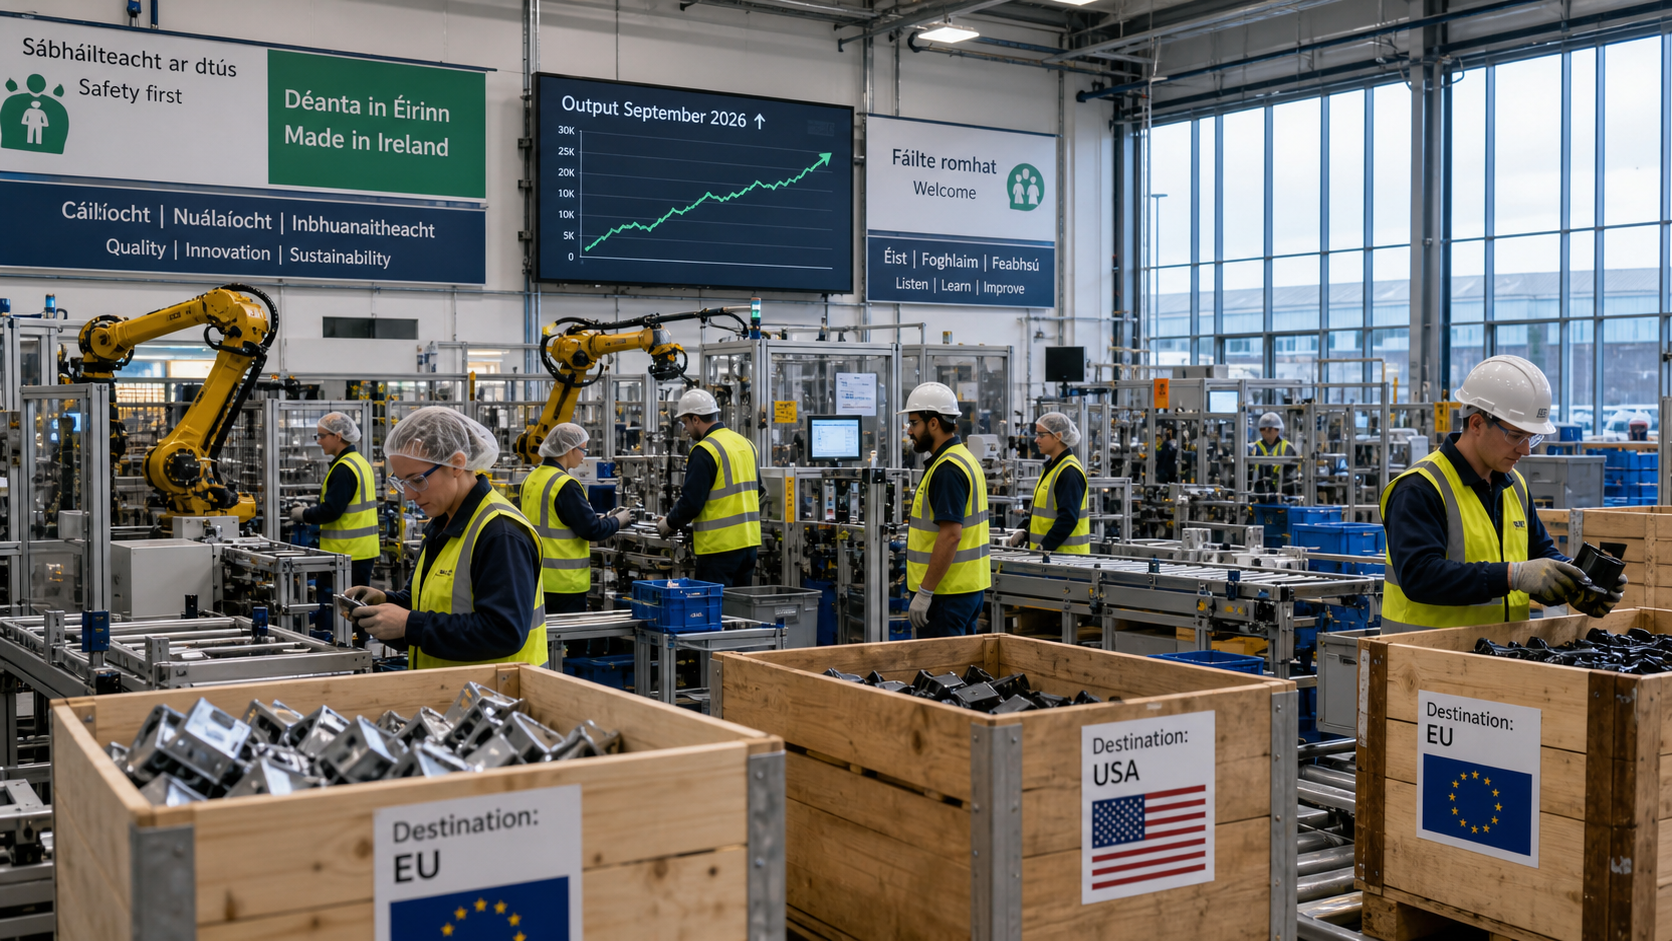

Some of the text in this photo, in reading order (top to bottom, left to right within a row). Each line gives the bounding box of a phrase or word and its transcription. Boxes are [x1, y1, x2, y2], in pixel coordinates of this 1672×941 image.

[22, 37, 236, 77] Sábháilteacht ar dtús
[79, 79, 182, 104] Safety first
[286, 89, 449, 122] Déanta in Éirinn
[562, 96, 746, 127] Output September 2026
[286, 125, 448, 156] Made in Ireland
[558, 126, 575, 135] 30K
[558, 147, 575, 156] 25K
[893, 149, 996, 174] Fáilte romhat
[558, 168, 575, 177] 20K
[558, 189, 575, 198] 10K
[913, 181, 976, 199] Welcome
[175, 208, 272, 229] Nuálaíocht
[293, 215, 435, 238] Inbhuanaitheacht
[558, 210, 575, 219] 10K
[563, 231, 575, 240] 5K
[107, 239, 391, 269] Quality Innovation Sustainability
[567, 252, 574, 261] 0
[885, 247, 1039, 271] Éist Foghlaim Feabhsú
[896, 277, 1024, 296] Listen Learn Improve
[1427, 701, 1514, 731] Destination:
[1093, 729, 1187, 754] Destination:
[1427, 724, 1452, 746] EU
[1094, 760, 1139, 786] USA
[393, 809, 538, 843] Destination:
[395, 850, 439, 883] EU
